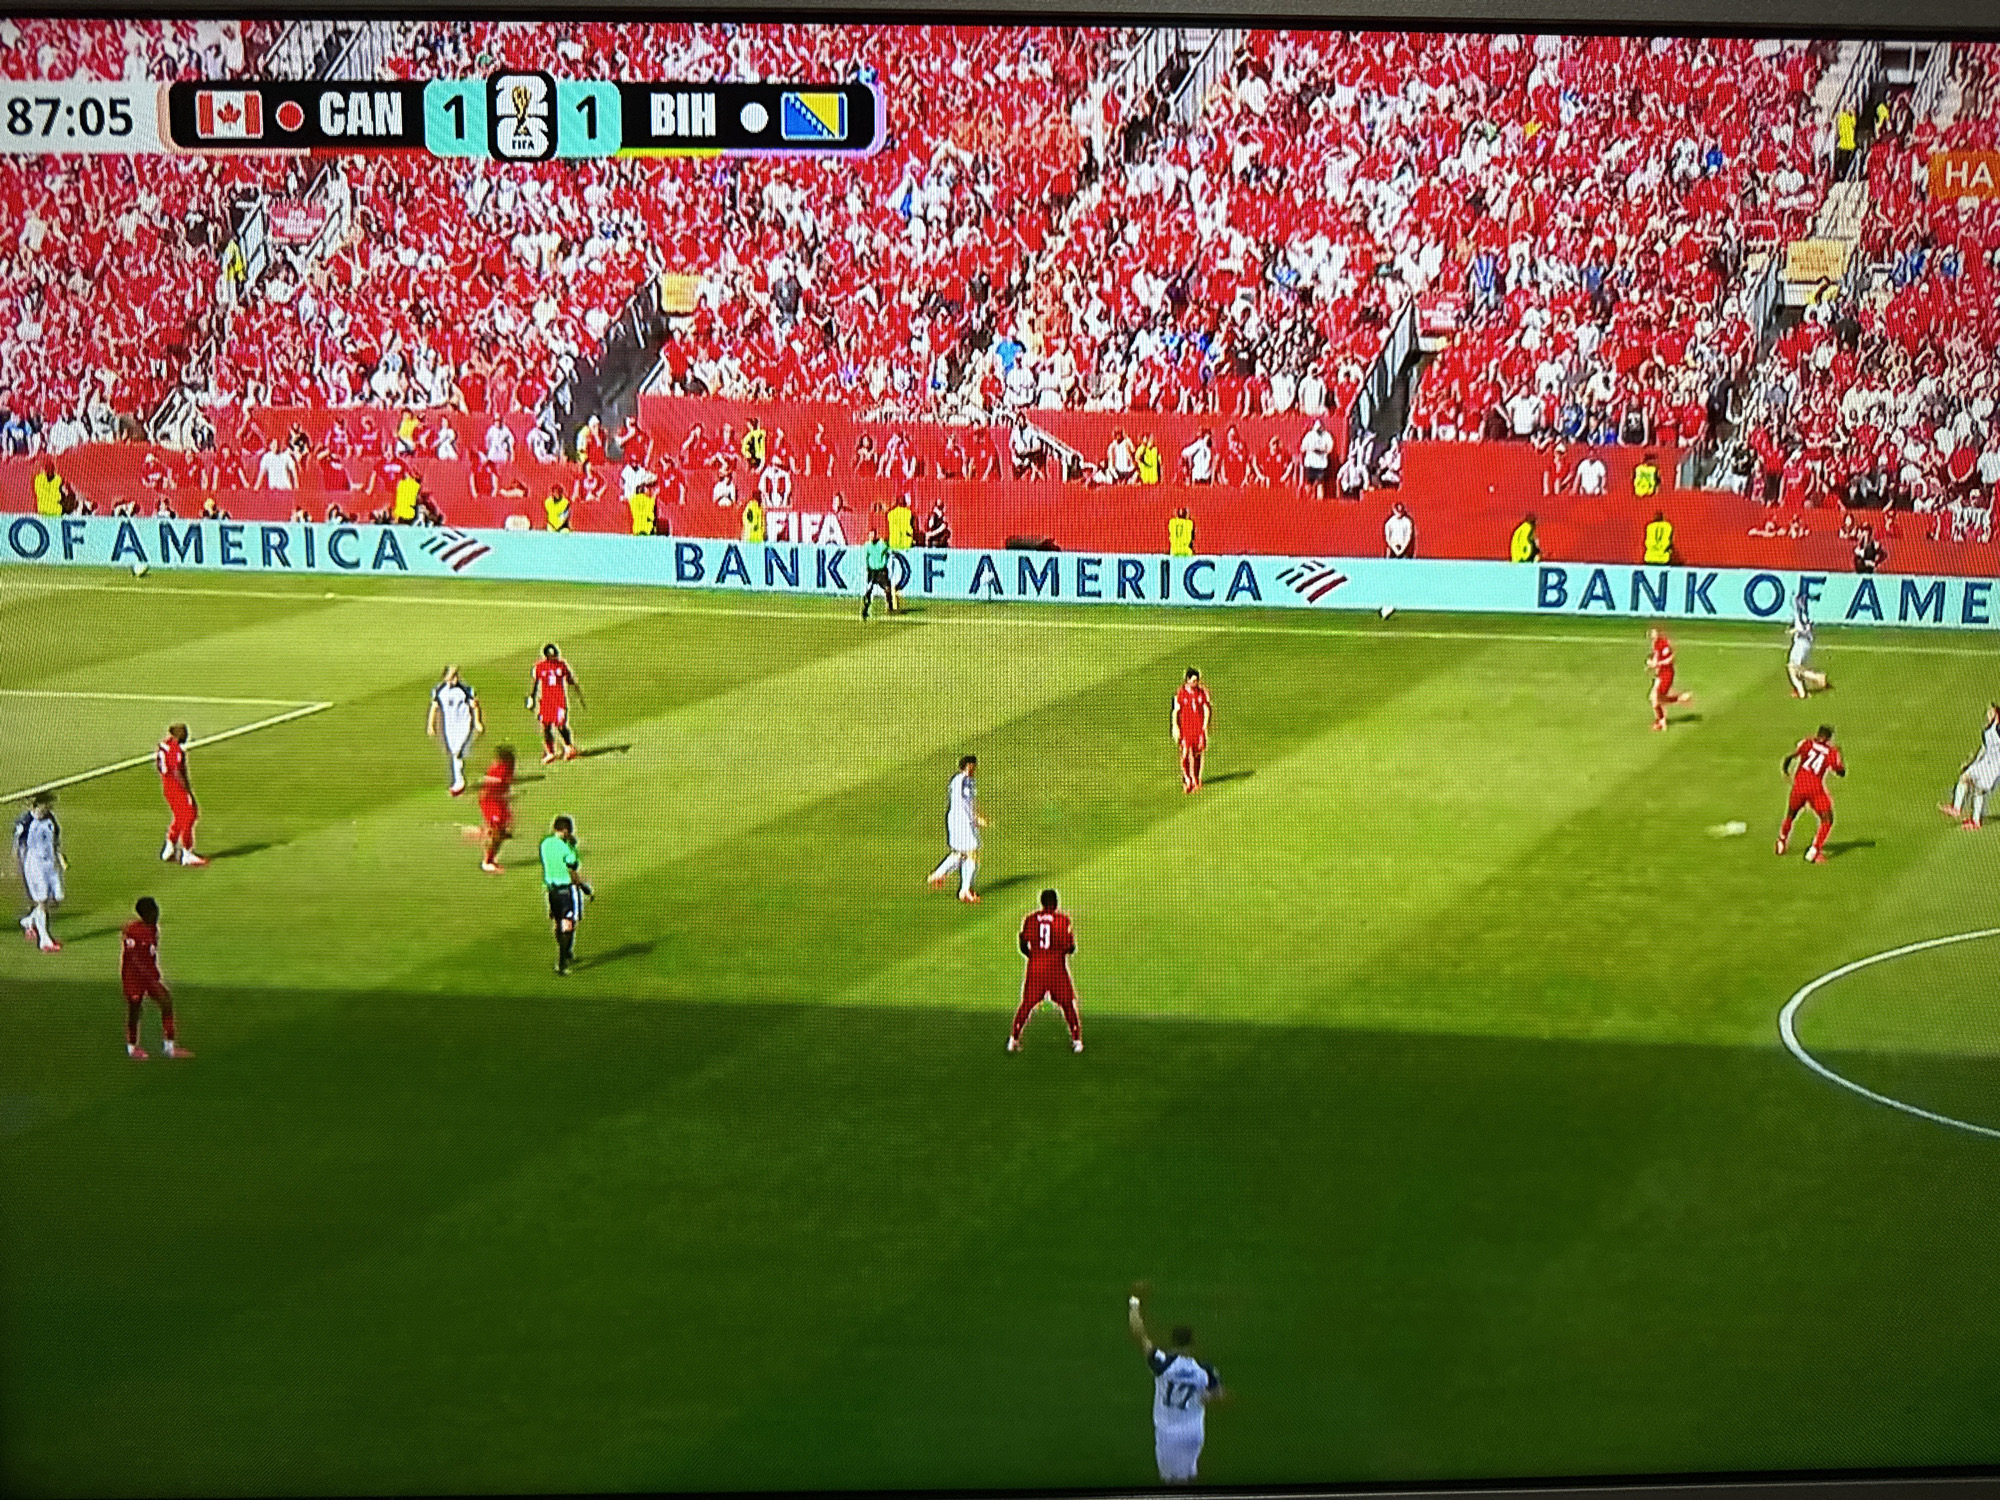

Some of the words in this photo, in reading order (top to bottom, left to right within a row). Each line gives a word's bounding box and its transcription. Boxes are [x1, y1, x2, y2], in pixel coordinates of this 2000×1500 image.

[7, 97, 134, 137] 87:05
[319, 91, 403, 137] CAN
[443, 94, 465, 140] 1
[575, 95, 597, 141] 1
[650, 92, 717, 138] BIH
[1945, 160, 1995, 189] HA
[9, 517, 86, 560] OF
[111, 519, 410, 572] AMERICA
[766, 511, 848, 546] FIFA
[675, 543, 848, 590] BANK
[969, 553, 1262, 602] AMERICA
[1537, 566, 1718, 615] BANK
[1744, 572, 1827, 620] OF
[1845, 577, 1993, 625] AME
[1802, 748, 1825, 776] 24
[1039, 922, 1051, 950] 9
[1162, 1380, 1197, 1410] 17
